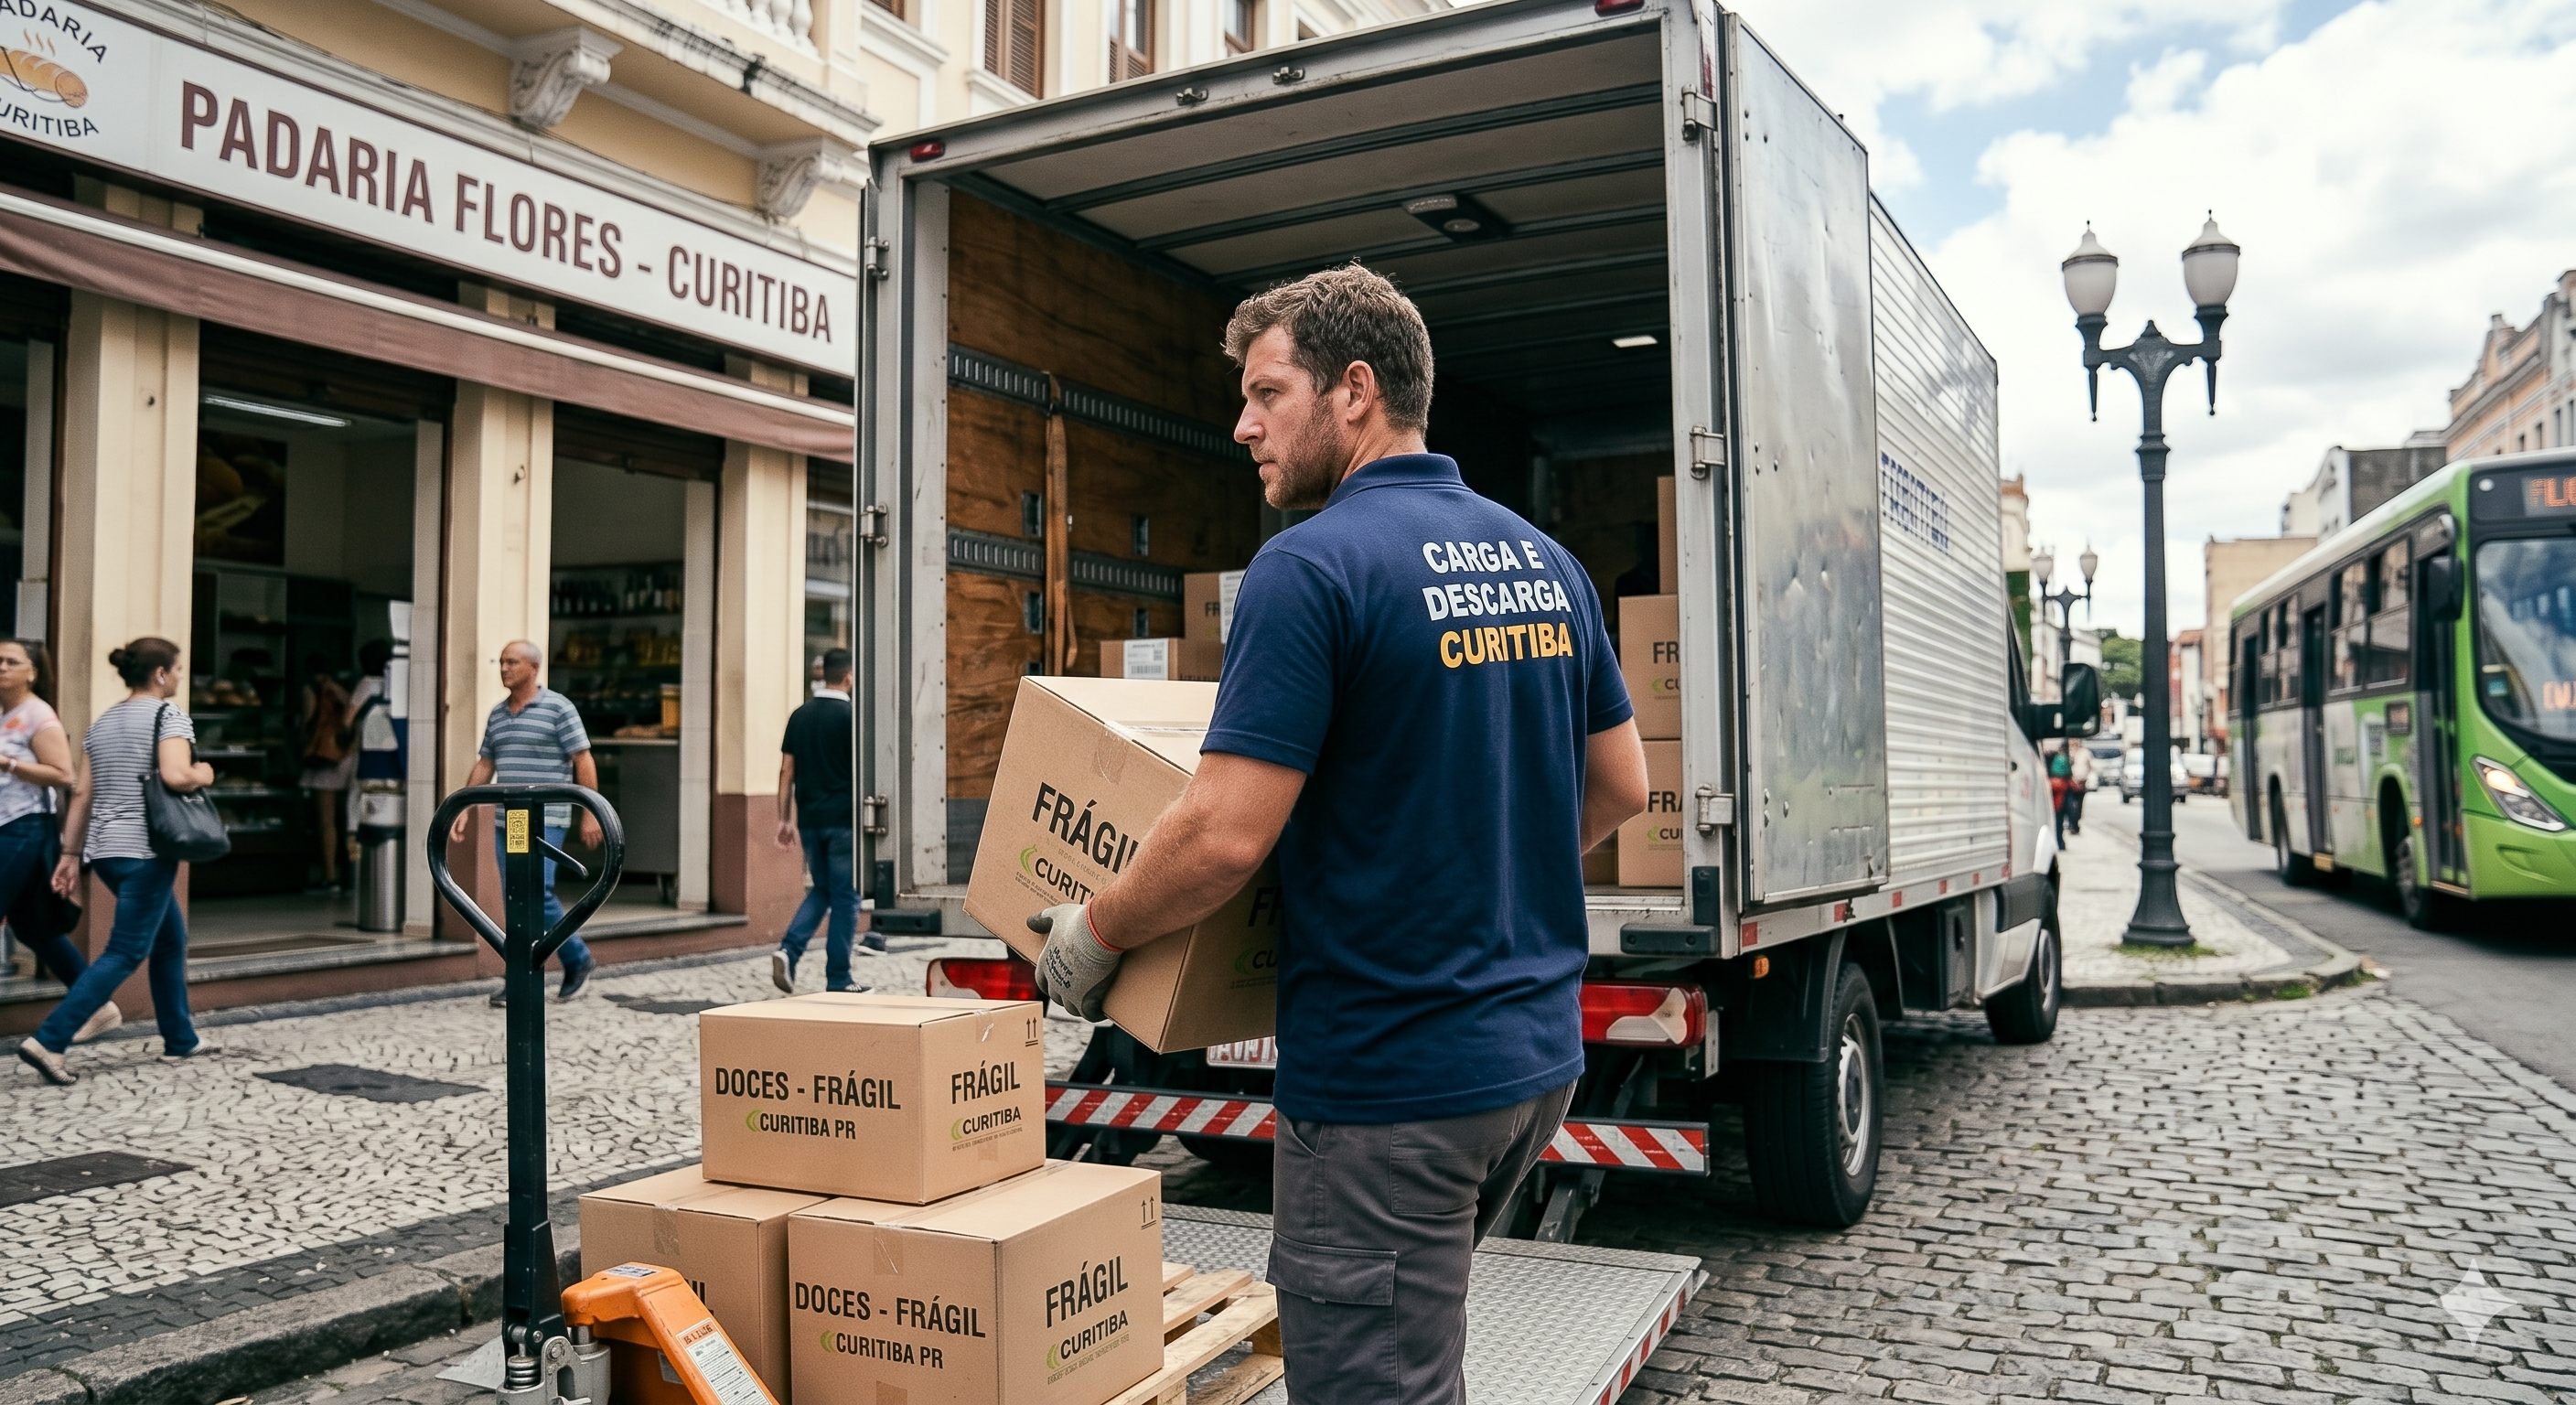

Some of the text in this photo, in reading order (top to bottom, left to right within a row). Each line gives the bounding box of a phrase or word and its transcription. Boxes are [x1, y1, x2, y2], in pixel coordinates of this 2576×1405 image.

[181, 80, 435, 225] PADARIA
[456, 172, 622, 279] FLORES
[668, 245, 832, 344] CURITIBA
[1422, 540, 1546, 574] CARGA E
[1422, 579, 1572, 621] DESCARGA
[1440, 622, 1573, 669] CURITIBA
[1659, 828, 1683, 841] CU
[1035, 857, 1095, 906] CURIT
[715, 1067, 789, 1102] DOCES
[813, 1069, 901, 1110] FRÁGIL
[951, 1059, 1021, 1105] FRÁGIL
[759, 1112, 856, 1140] CURITIBA PR
[962, 1106, 1022, 1135] CURITIBA
[795, 1282, 871, 1321] DOCES
[896, 1295, 986, 1338] FRÁGIL
[1046, 1255, 1129, 1329] FRÁGIL
[836, 1332, 944, 1369] CURITIBA PR
[1060, 1309, 1129, 1360] CURITIBA
